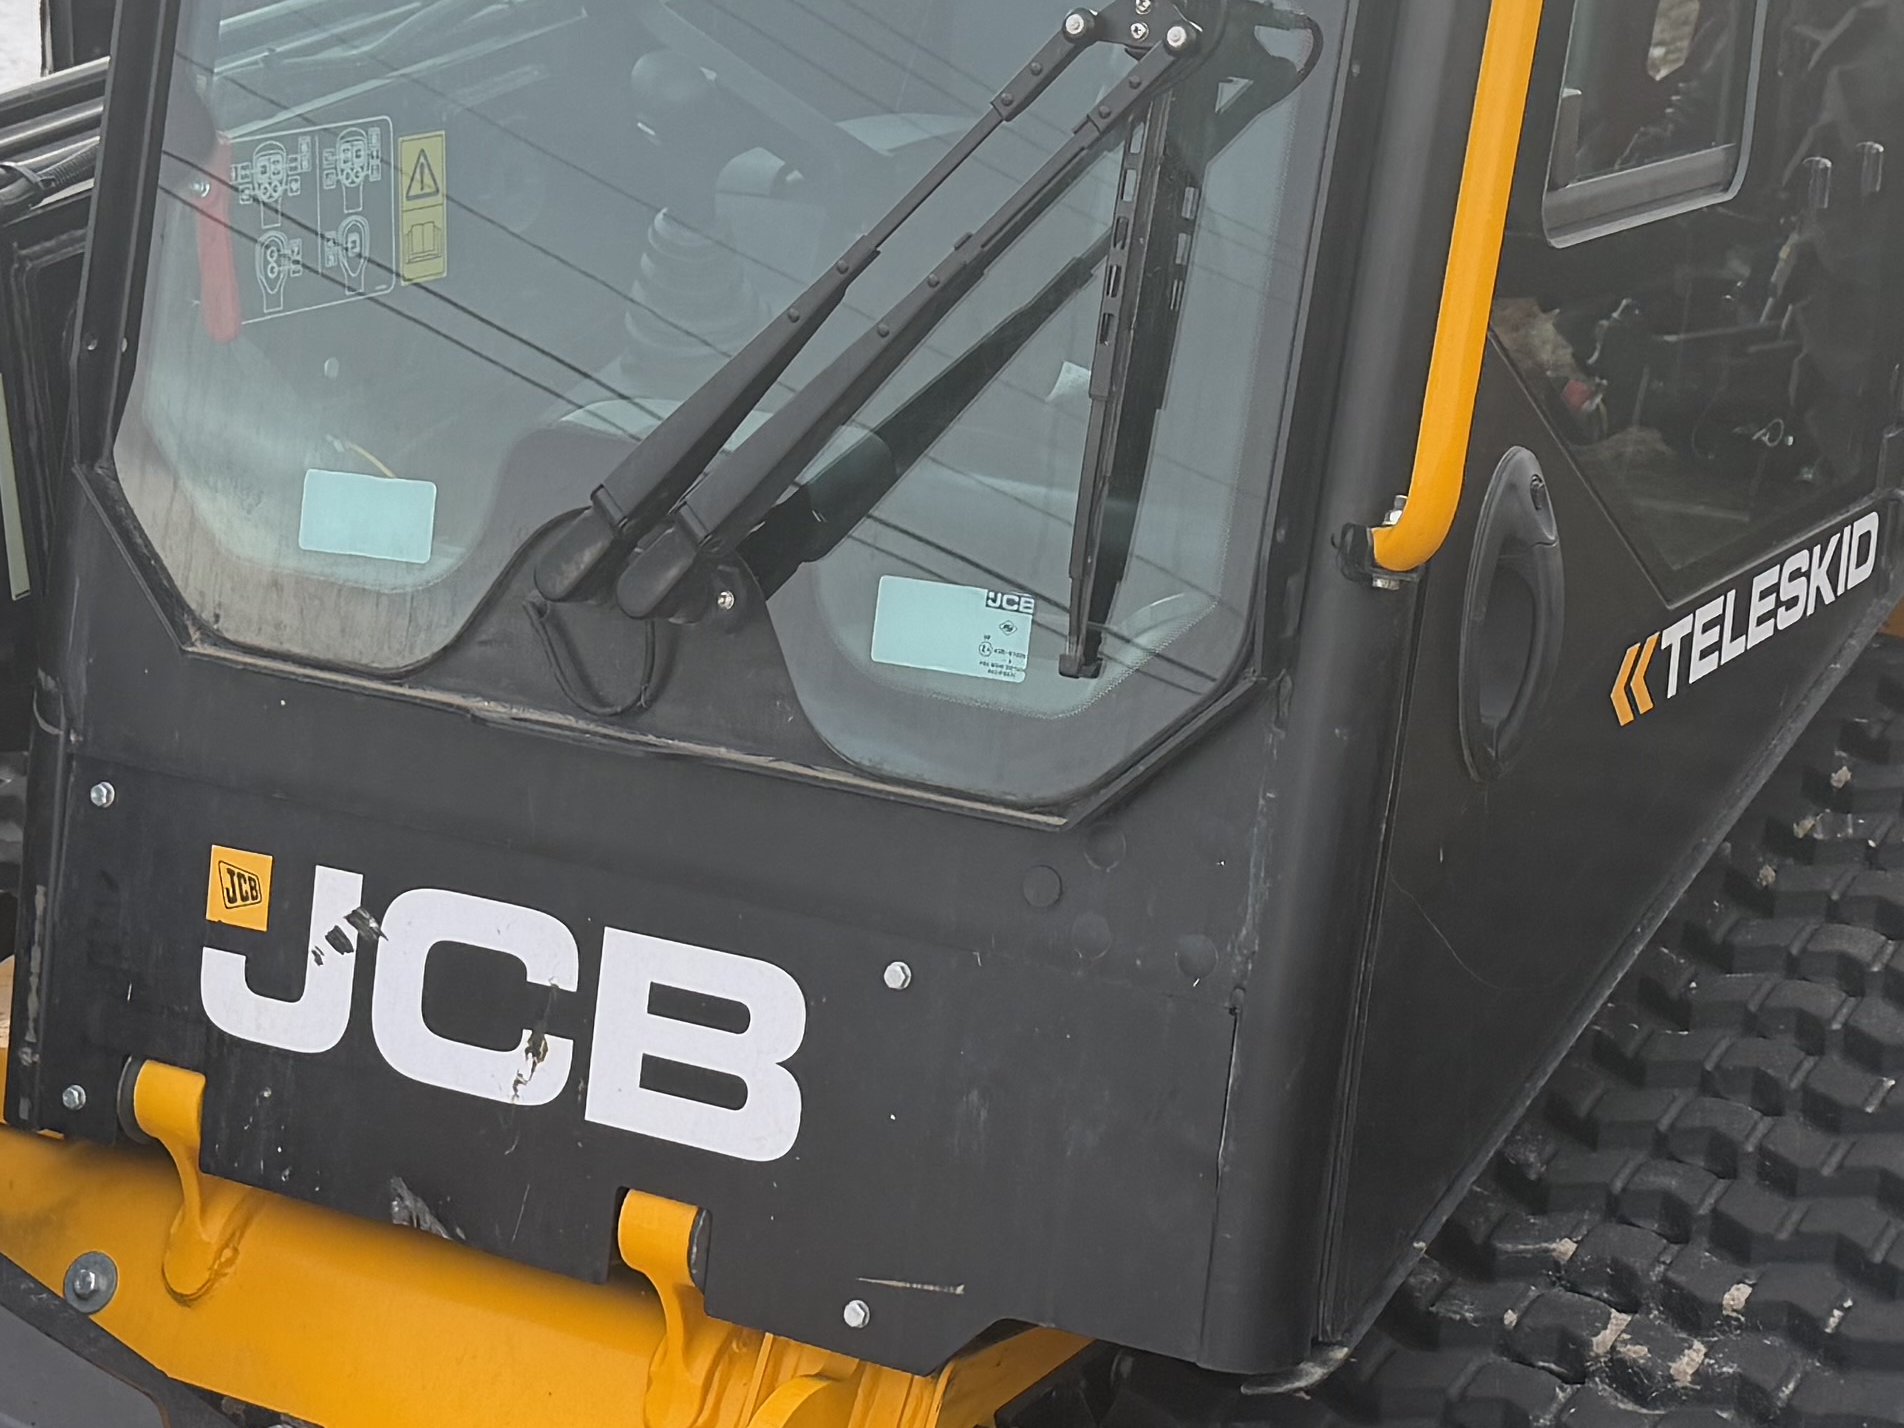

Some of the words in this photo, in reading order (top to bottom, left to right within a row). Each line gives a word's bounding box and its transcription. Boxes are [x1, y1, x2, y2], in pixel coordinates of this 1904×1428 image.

[1660, 511, 1880, 699] TELESKID
[224, 867, 259, 905] JCB
[200, 864, 807, 1162] JCB
